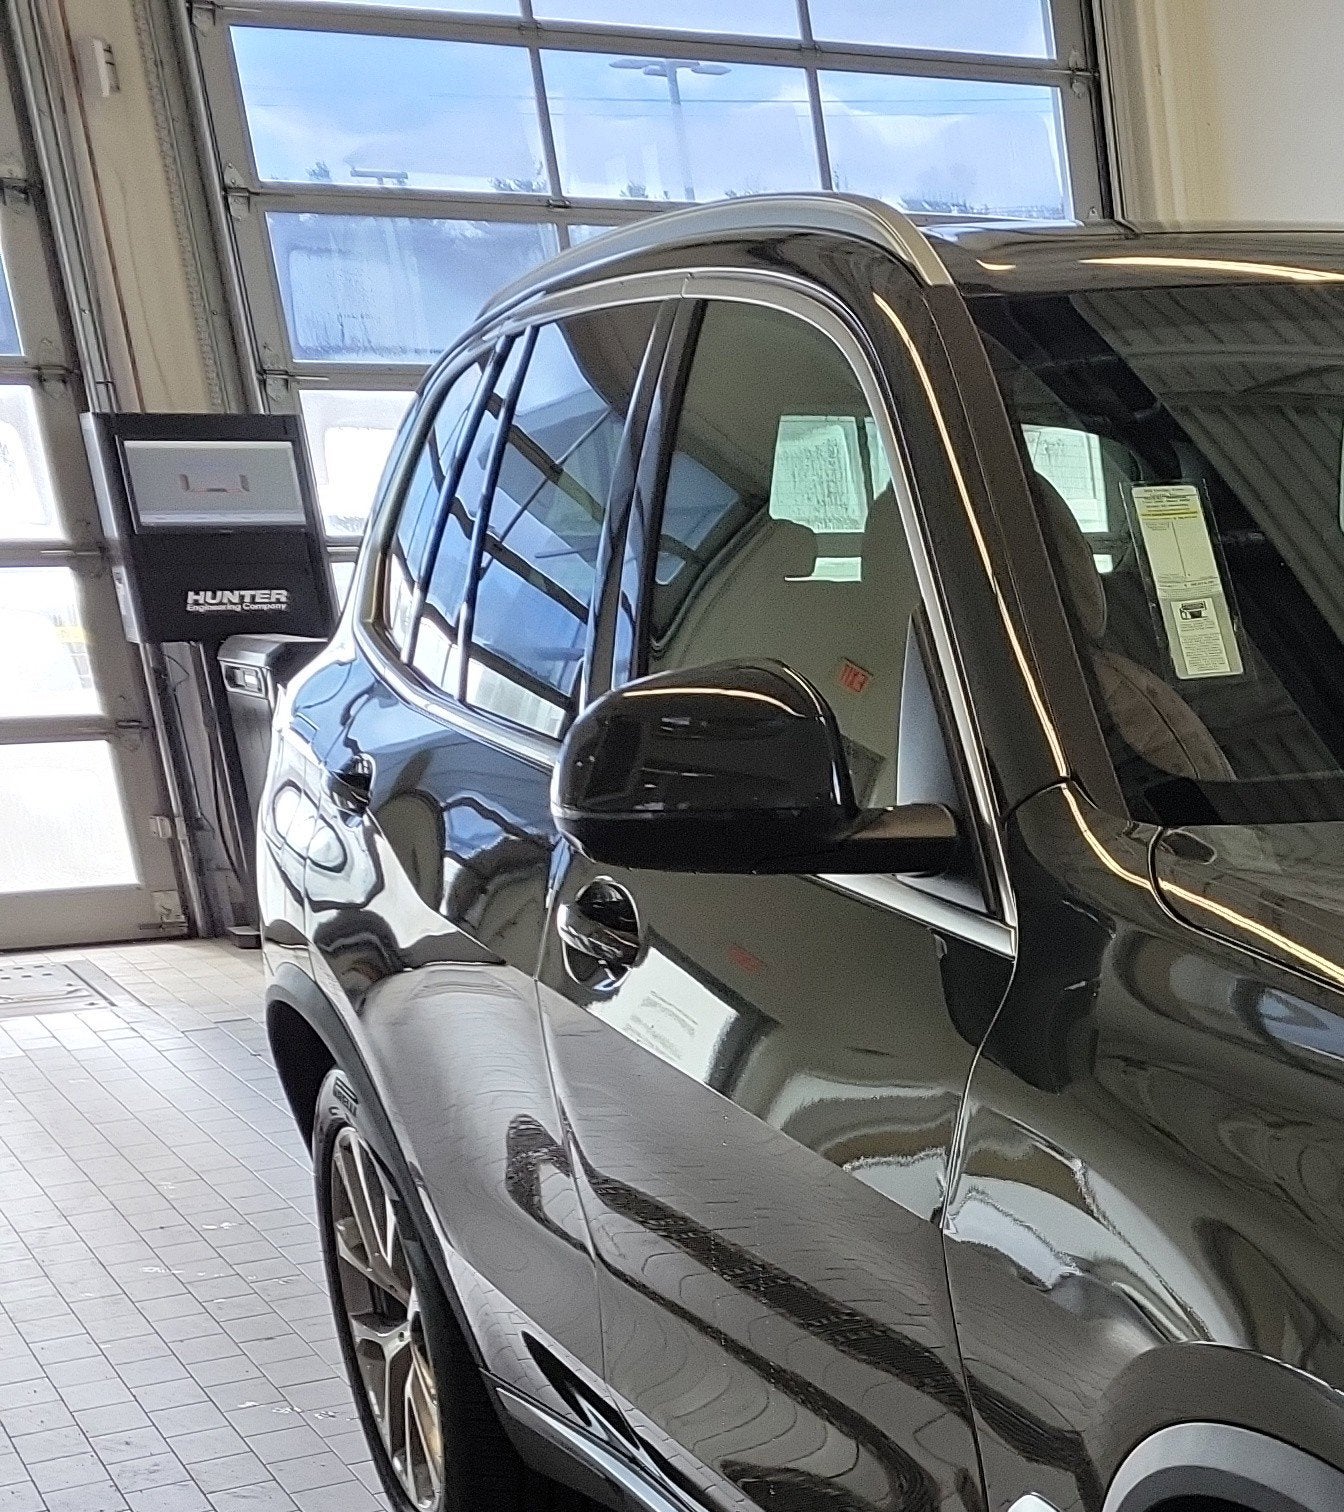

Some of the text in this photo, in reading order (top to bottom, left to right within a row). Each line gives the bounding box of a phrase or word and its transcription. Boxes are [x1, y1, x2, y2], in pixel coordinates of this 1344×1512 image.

[187, 589, 288, 604] HUNTER
[186, 602, 287, 613] Engineering Company
